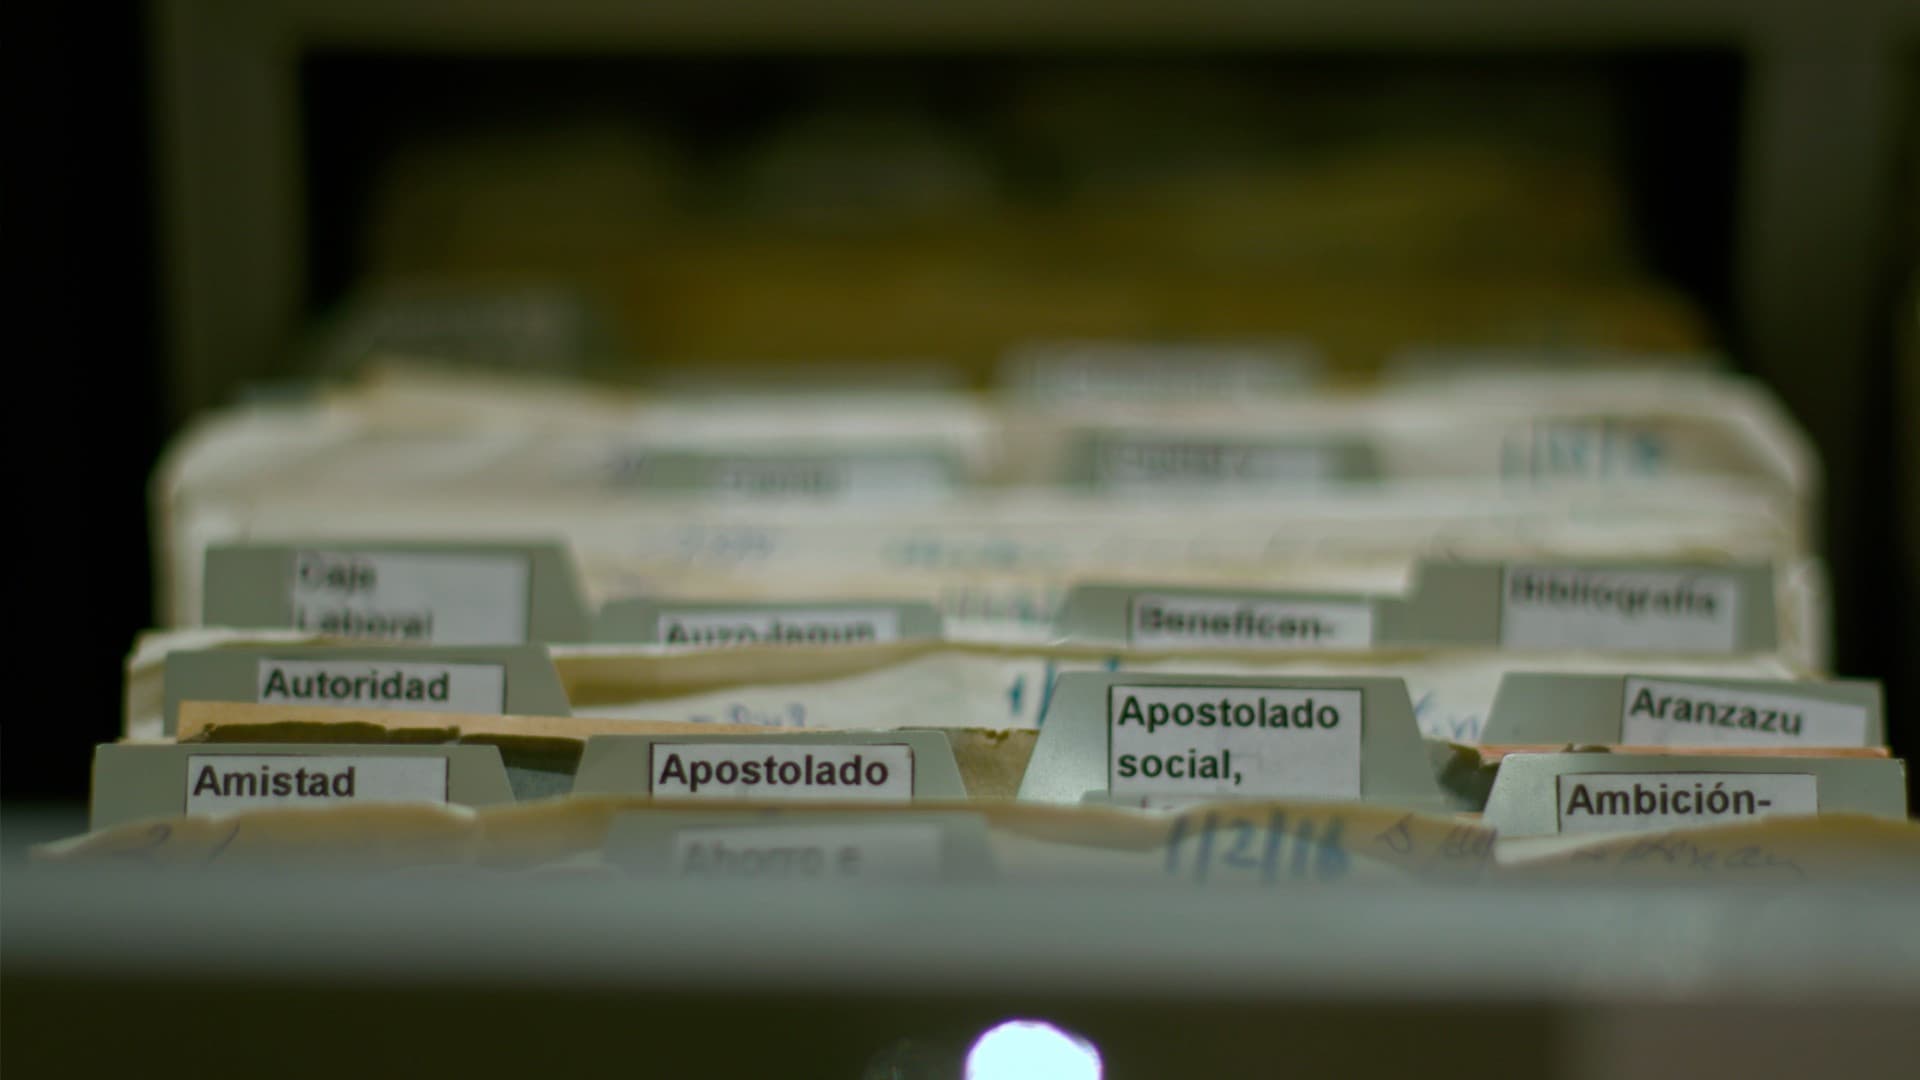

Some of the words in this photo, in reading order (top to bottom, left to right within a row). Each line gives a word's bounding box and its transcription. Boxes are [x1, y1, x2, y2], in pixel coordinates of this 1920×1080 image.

[263, 667, 450, 702] Autoridad
[1117, 695, 1341, 734] Apostolado
[1629, 688, 1804, 737] Aranzazu
[193, 765, 356, 798] Amistad
[658, 752, 889, 793] Apostolado
[1117, 748, 1244, 785] social,
[1566, 782, 1773, 816] Ambición-
